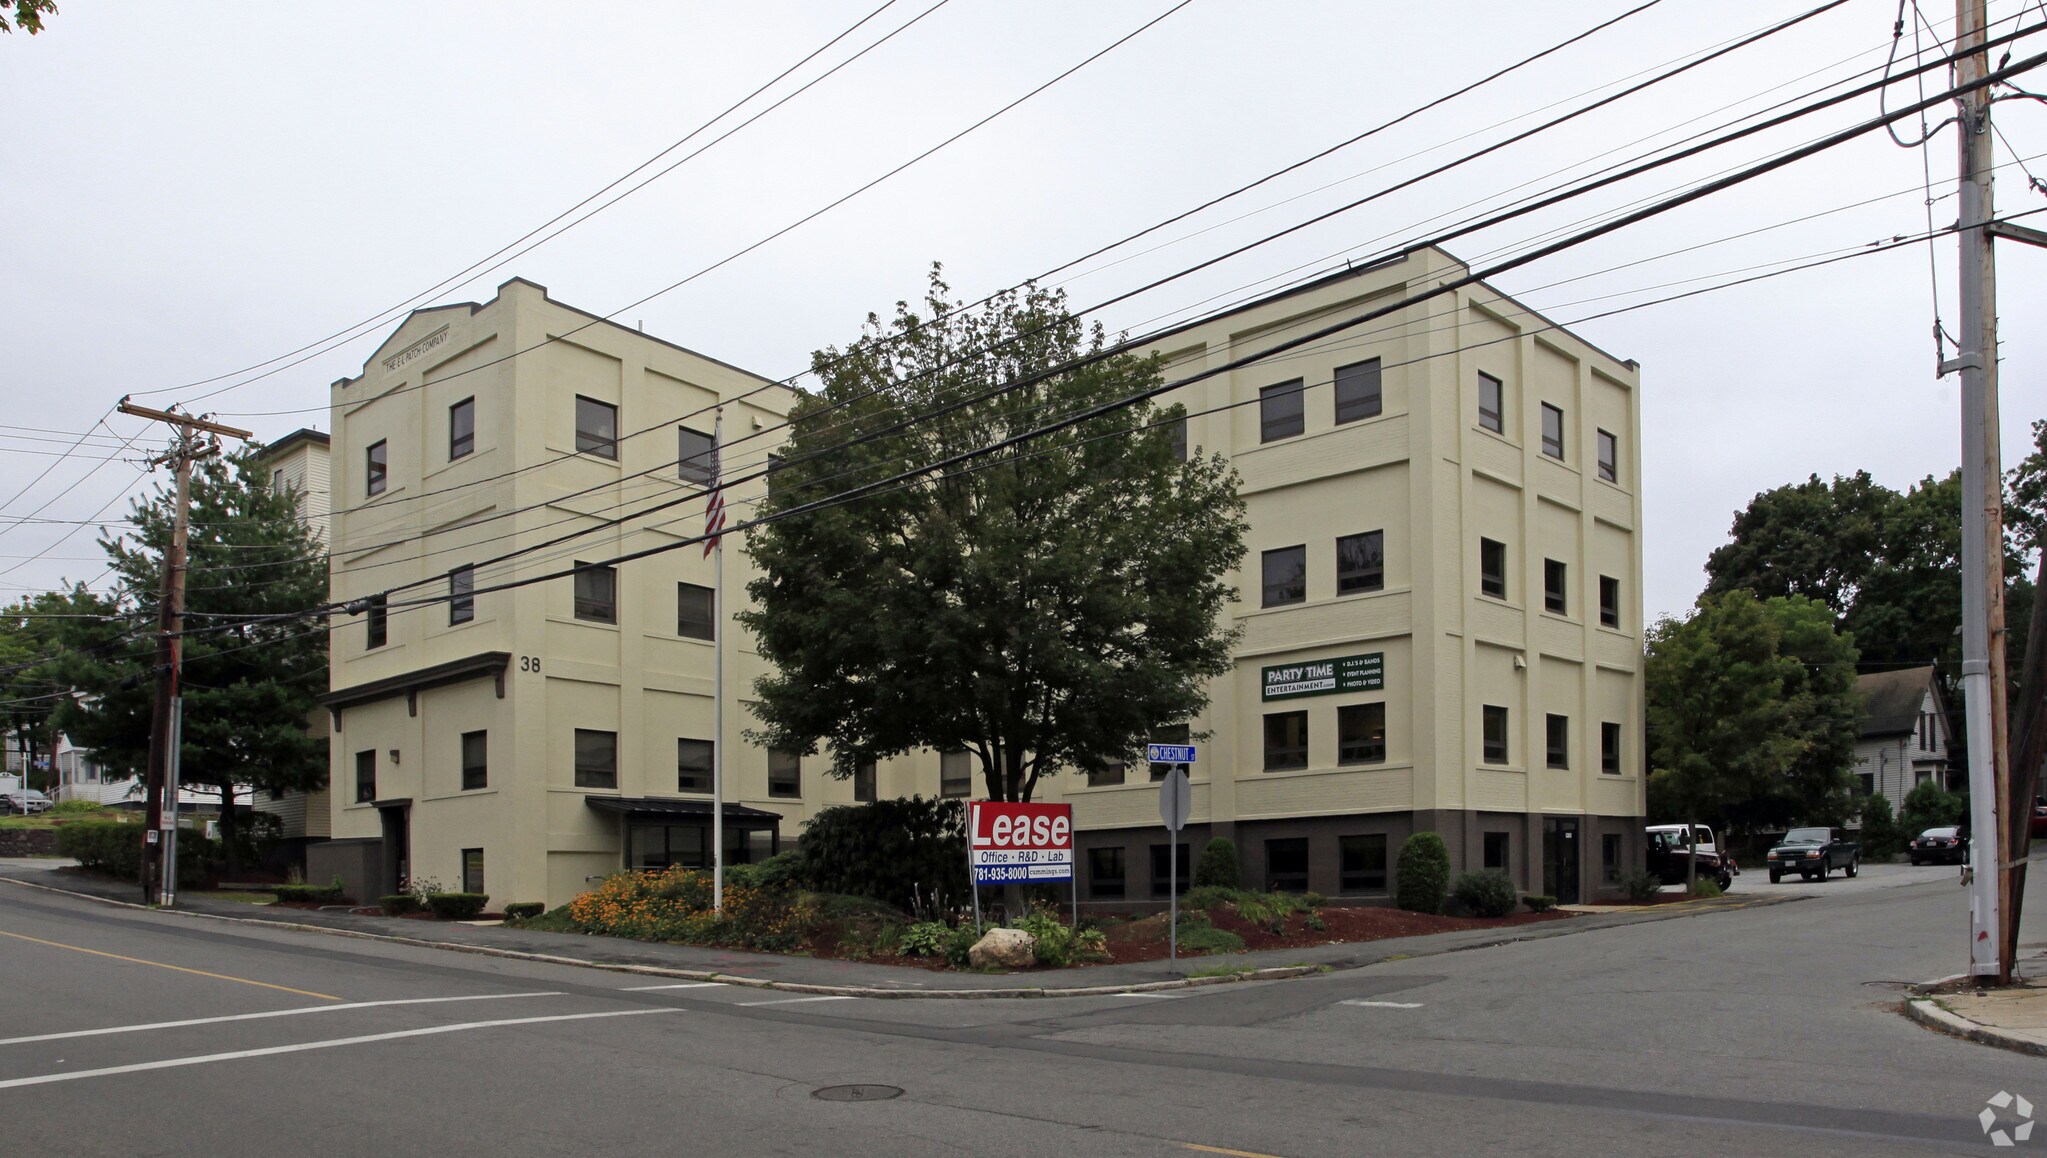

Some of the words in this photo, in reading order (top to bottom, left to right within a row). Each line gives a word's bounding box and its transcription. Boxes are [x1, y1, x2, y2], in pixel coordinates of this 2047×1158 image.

[386, 360, 396, 373] THE
[405, 346, 421, 362] PATCH
[422, 331, 448, 353] COMPANY
[520, 655, 541, 673] 38
[1364, 657, 1380, 665] BANDS
[1267, 667, 1303, 684] PARTY
[1305, 663, 1334, 679] TIME
[1359, 668, 1381, 676] PLANNING
[1160, 746, 1189, 760] CHESTNUT
[972, 804, 1070, 846] Lease
[981, 851, 1008, 863] Office
[1018, 851, 1039, 862] R&D
[1047, 850, 1064, 861] Lab
[974, 867, 1027, 881] 781-935-8000
